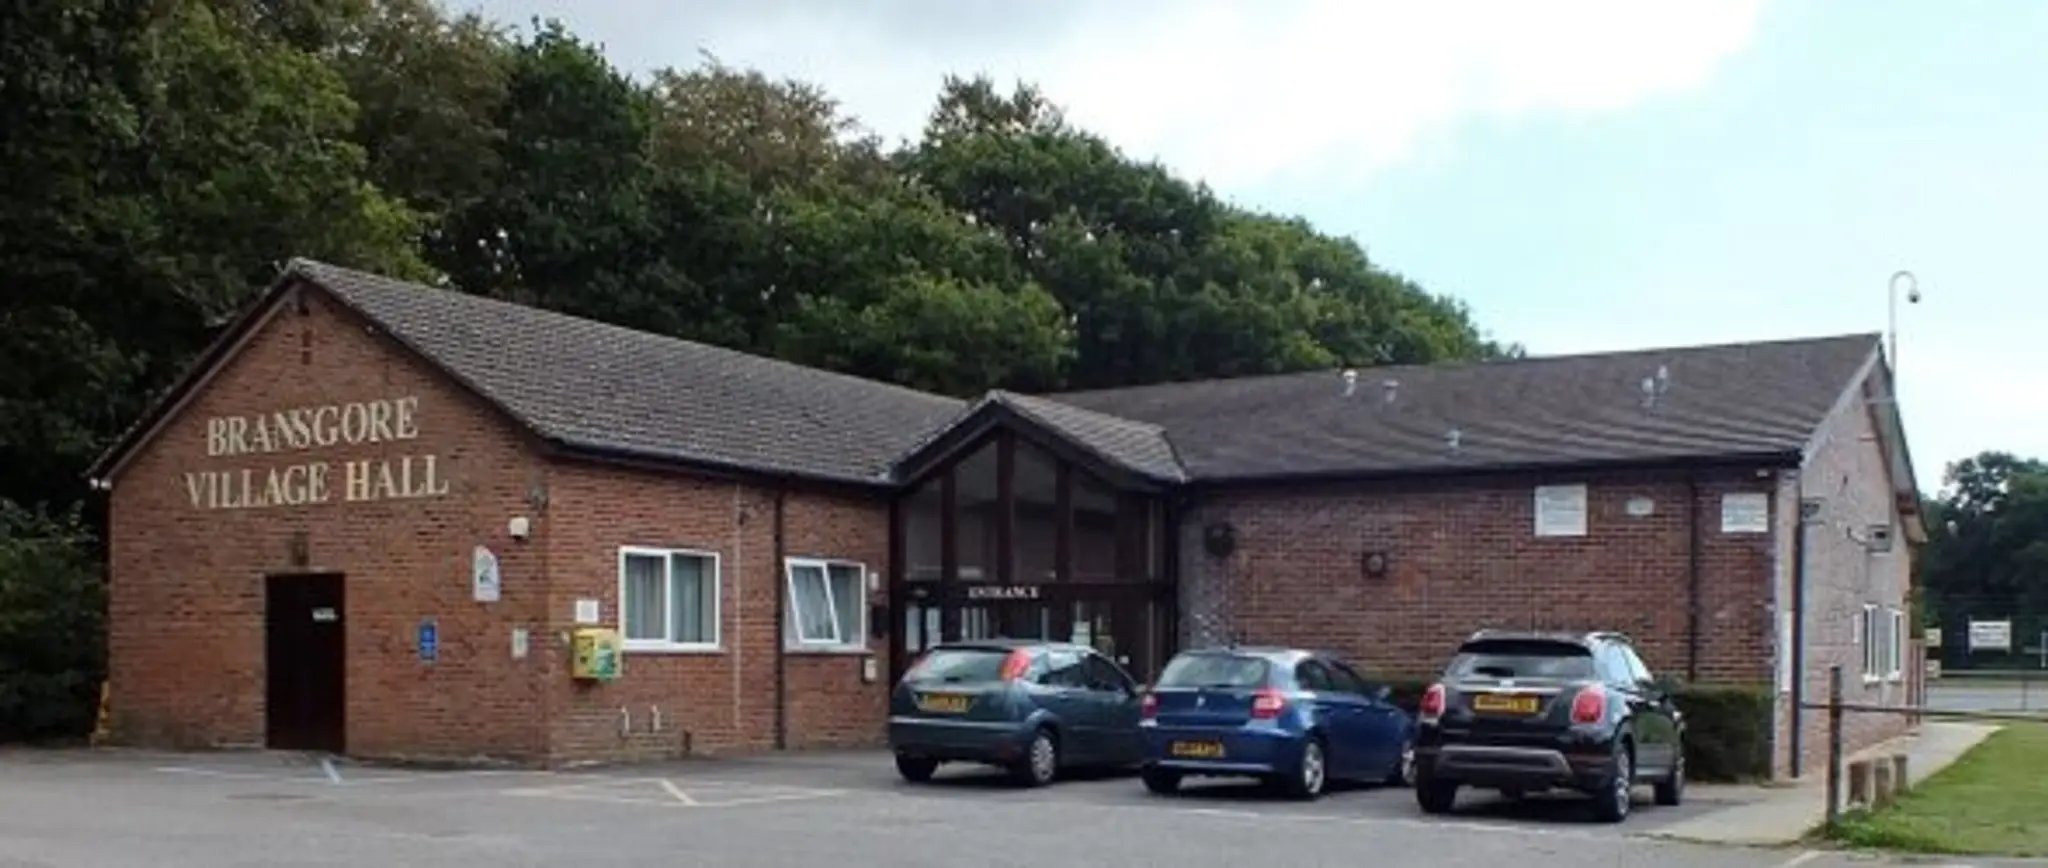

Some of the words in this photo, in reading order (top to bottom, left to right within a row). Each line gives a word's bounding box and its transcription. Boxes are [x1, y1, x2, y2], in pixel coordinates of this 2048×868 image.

[207, 397, 419, 457] BRANSGORE
[185, 463, 329, 509] VILLAGE
[346, 454, 450, 502] HALL
